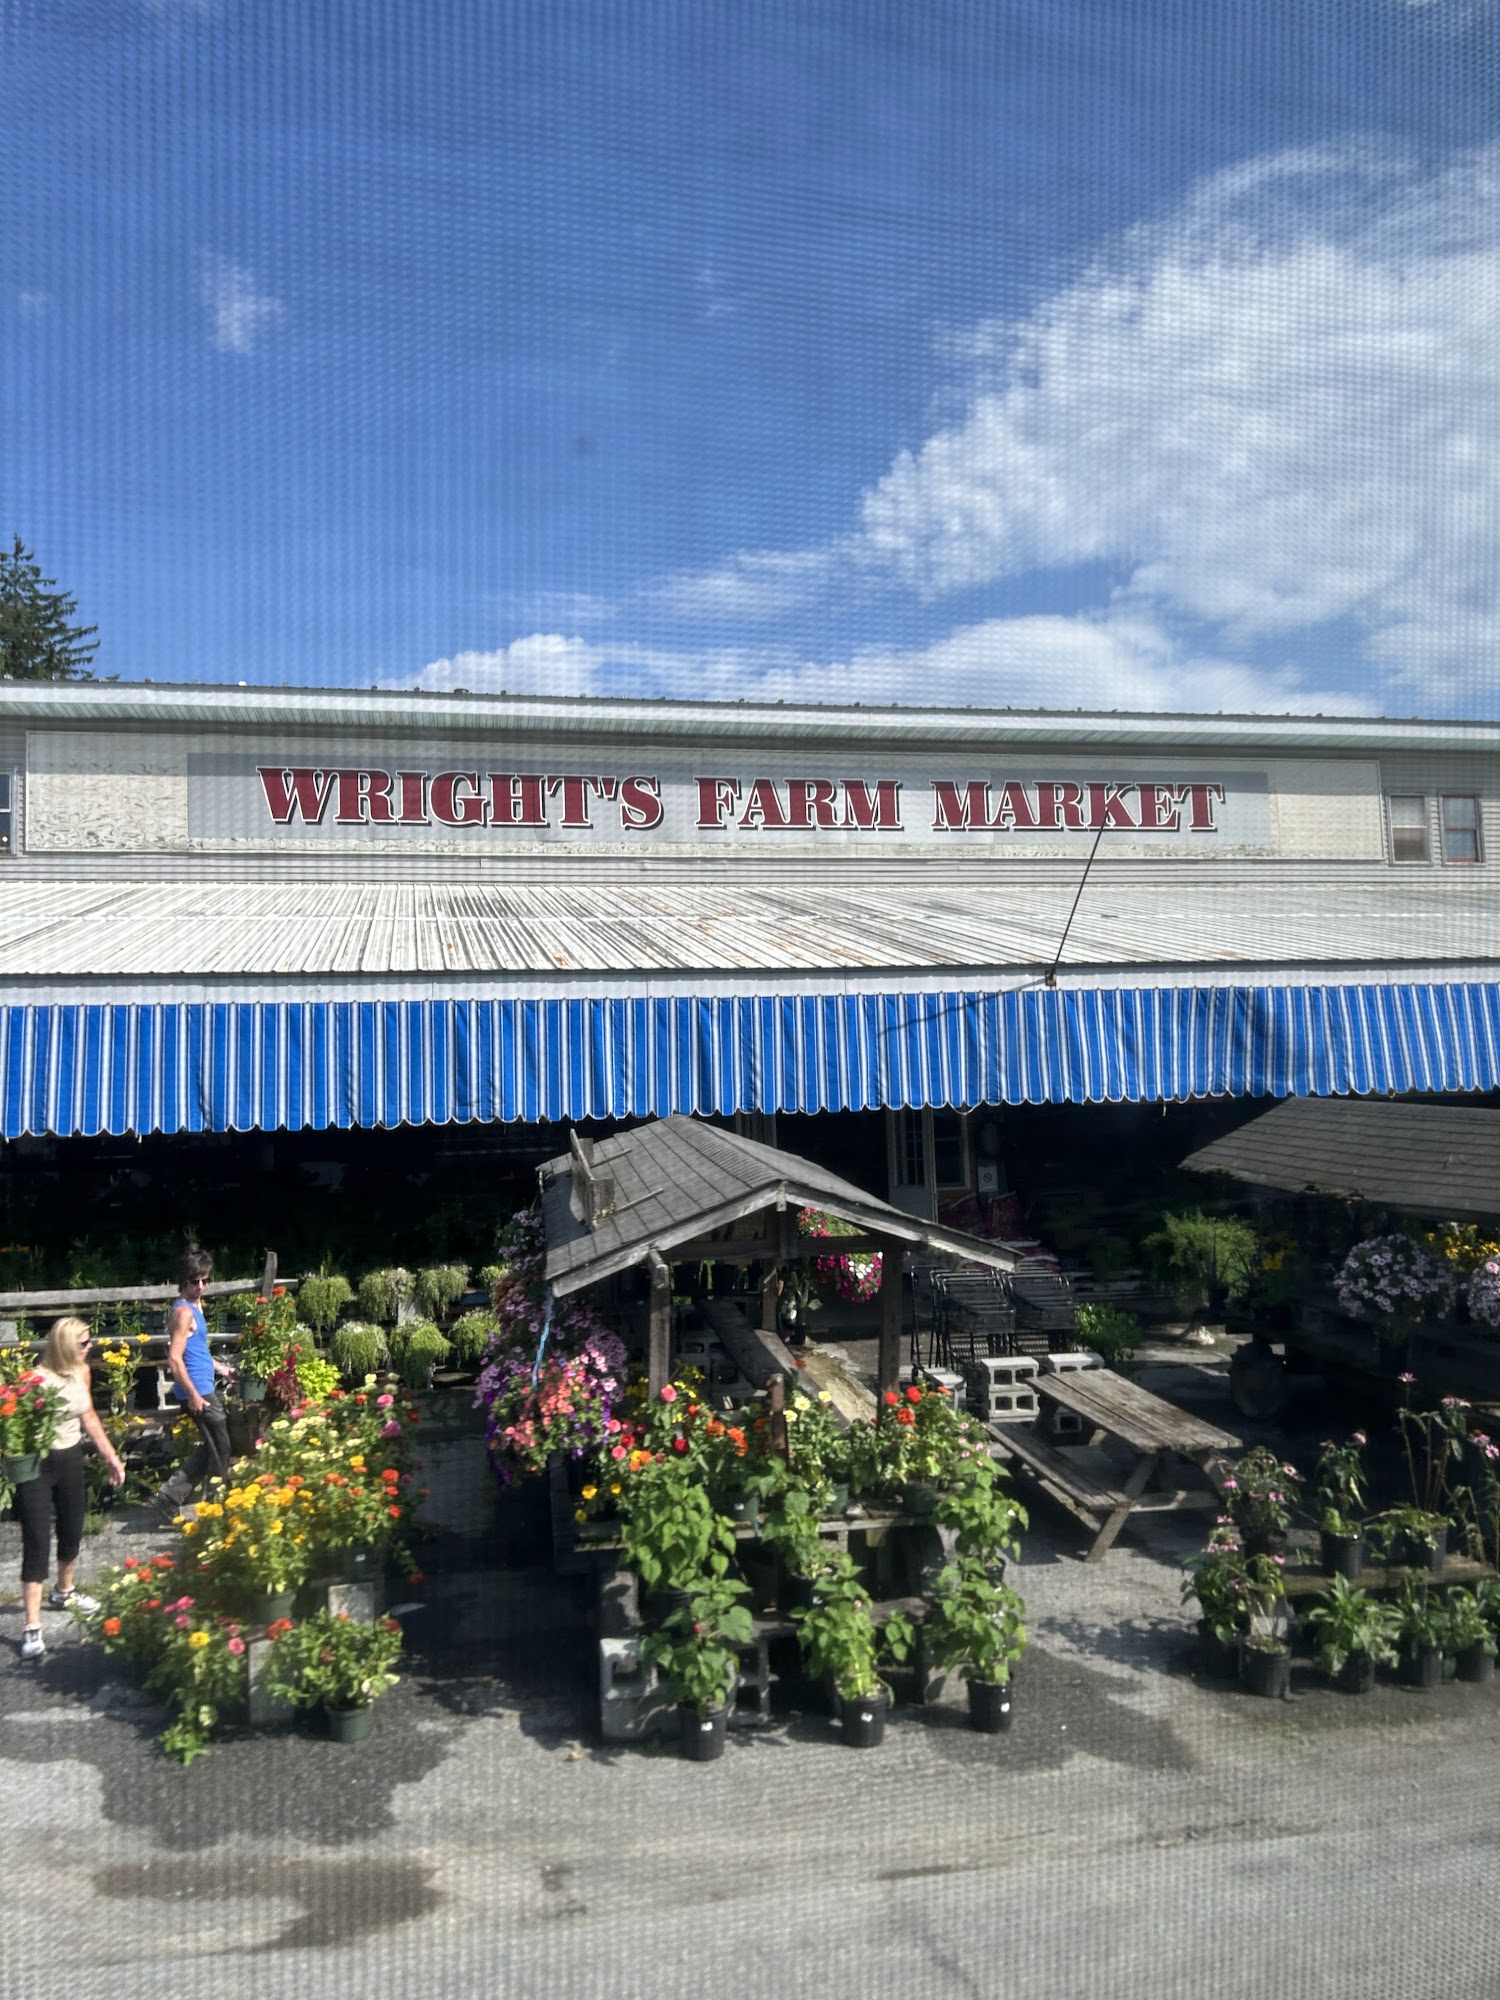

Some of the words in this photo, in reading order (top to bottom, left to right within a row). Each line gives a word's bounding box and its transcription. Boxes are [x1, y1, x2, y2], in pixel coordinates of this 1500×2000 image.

[256, 765, 664, 830] WRIGHT'S
[693, 776, 904, 832] FARM
[930, 779, 1225, 833] MARKET
